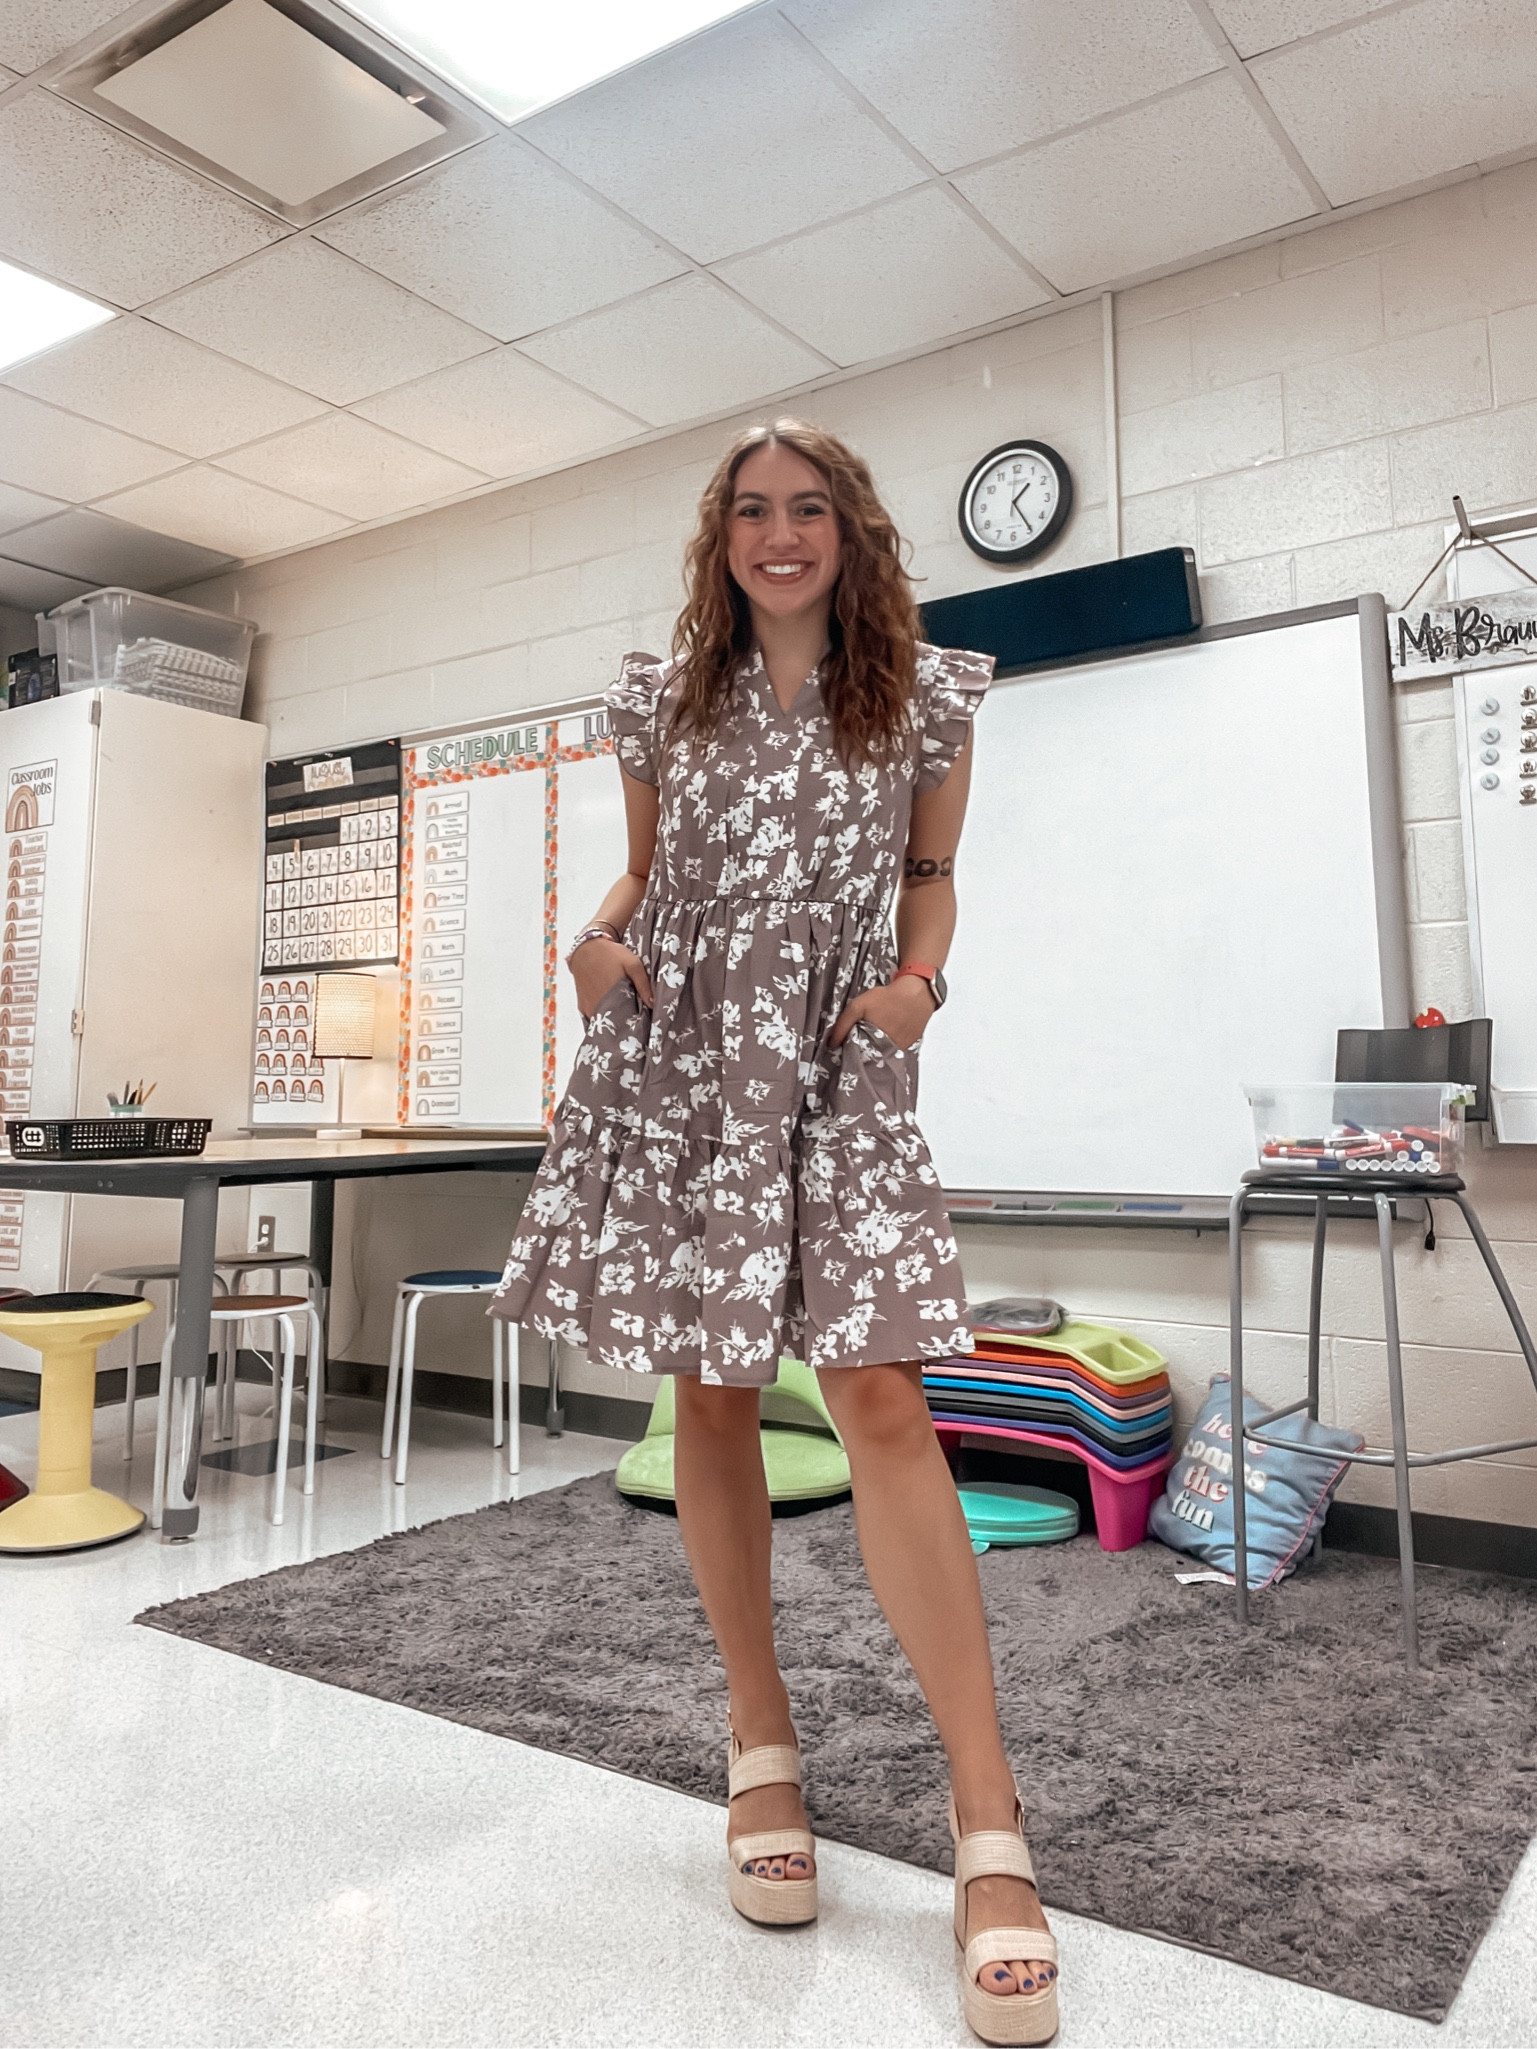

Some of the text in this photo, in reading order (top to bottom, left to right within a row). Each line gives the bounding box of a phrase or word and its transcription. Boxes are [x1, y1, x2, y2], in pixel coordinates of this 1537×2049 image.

[1012, 464, 1022, 474] 12
[1030, 466, 1035, 475] 1
[996, 472, 1005, 482] 11
[1040, 475, 1047, 485] 2
[986, 485, 996, 494] 10
[1044, 493, 1050, 502] 3
[980, 504, 987, 513] 9
[1038, 511, 1045, 520] 4
[984, 520, 991, 529] 8
[995, 530, 1003, 540] 7
[1010, 532, 1017, 541] 6
[427, 727, 538, 769] SCHEDULE
[11, 766, 54, 785] Classroom
[31, 782, 52, 797] Jobs
[348, 815, 392, 839] 1 2 3
[272, 843, 392, 875] 4 5 6 7 8 9 10
[271, 874, 391, 905] 11 12 13 14 15 16 17
[270, 904, 394, 934] 18 19 20 21 22 23 24
[268, 933, 392, 961] 25 26 27 28 29 30 31
[1202, 1413, 1269, 1456] hee
[1183, 1438, 1267, 1493] coms
[1183, 1464, 1228, 1503] the
[1172, 1490, 1215, 1533] fun
